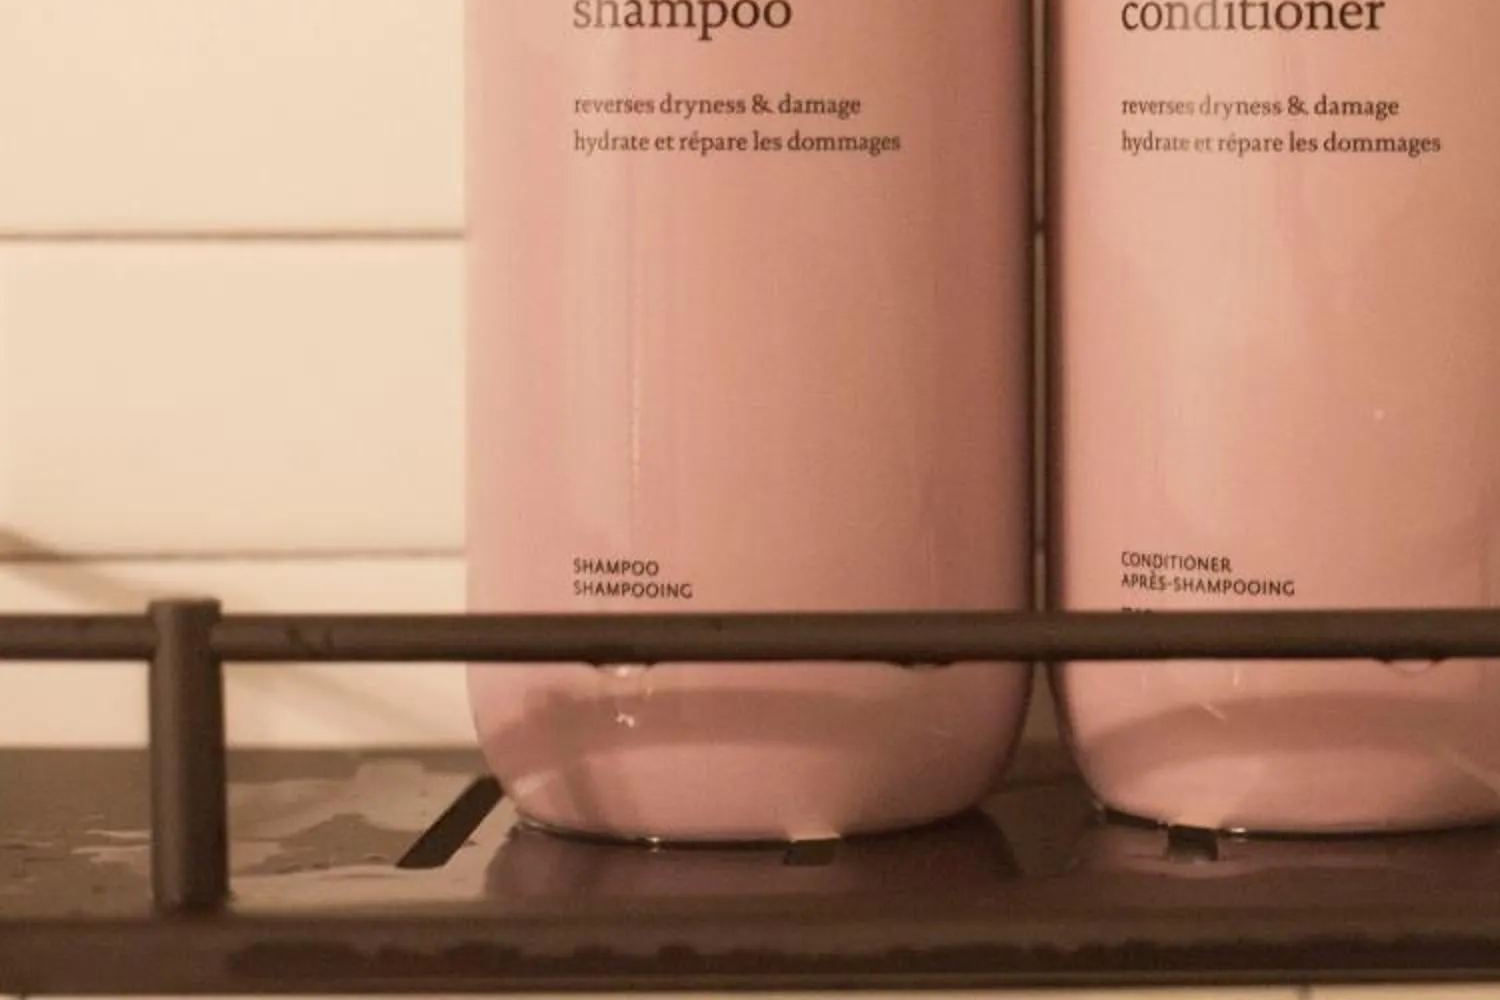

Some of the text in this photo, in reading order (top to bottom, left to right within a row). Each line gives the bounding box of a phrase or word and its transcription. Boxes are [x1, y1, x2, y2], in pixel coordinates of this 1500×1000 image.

[574, 94, 861, 120] reverses dryness & damage
[1121, 94, 1399, 121] reverses dryness & damage
[574, 130, 901, 157] hydrate et répare les dommages
[1121, 131, 1441, 158] hydrate et répare les dommages
[573, 557, 659, 576] SHAMPOO
[1121, 551, 1232, 573] CONDITIONER
[573, 580, 693, 599] SHAMPOOING
[1121, 570, 1295, 597] APRÈS-SHAMPOOING
